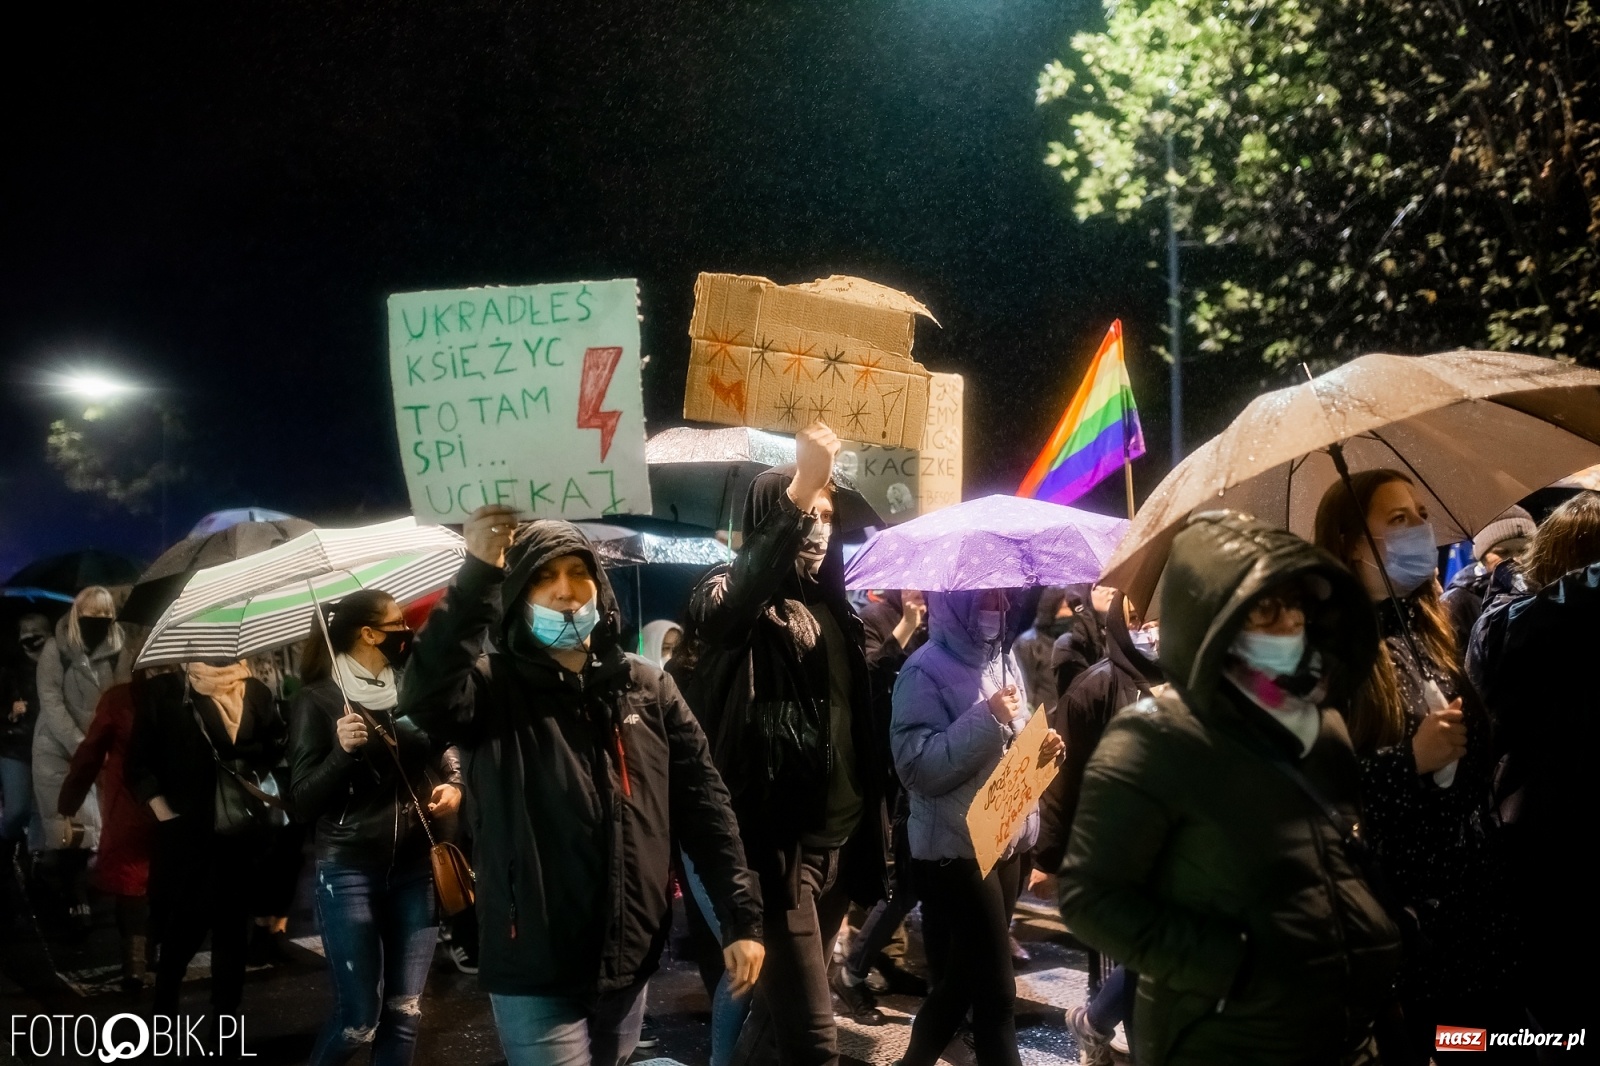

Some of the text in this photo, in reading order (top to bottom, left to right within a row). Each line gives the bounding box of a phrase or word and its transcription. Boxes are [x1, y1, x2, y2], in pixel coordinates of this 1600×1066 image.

[402, 285, 592, 339] UKRADŁEŚ
[402, 386, 551, 436] TO TAM
[864, 456, 955, 479] KACZKĘ
[426, 470, 626, 515] UCIEKAJ
[623, 713, 640, 725] 4F
